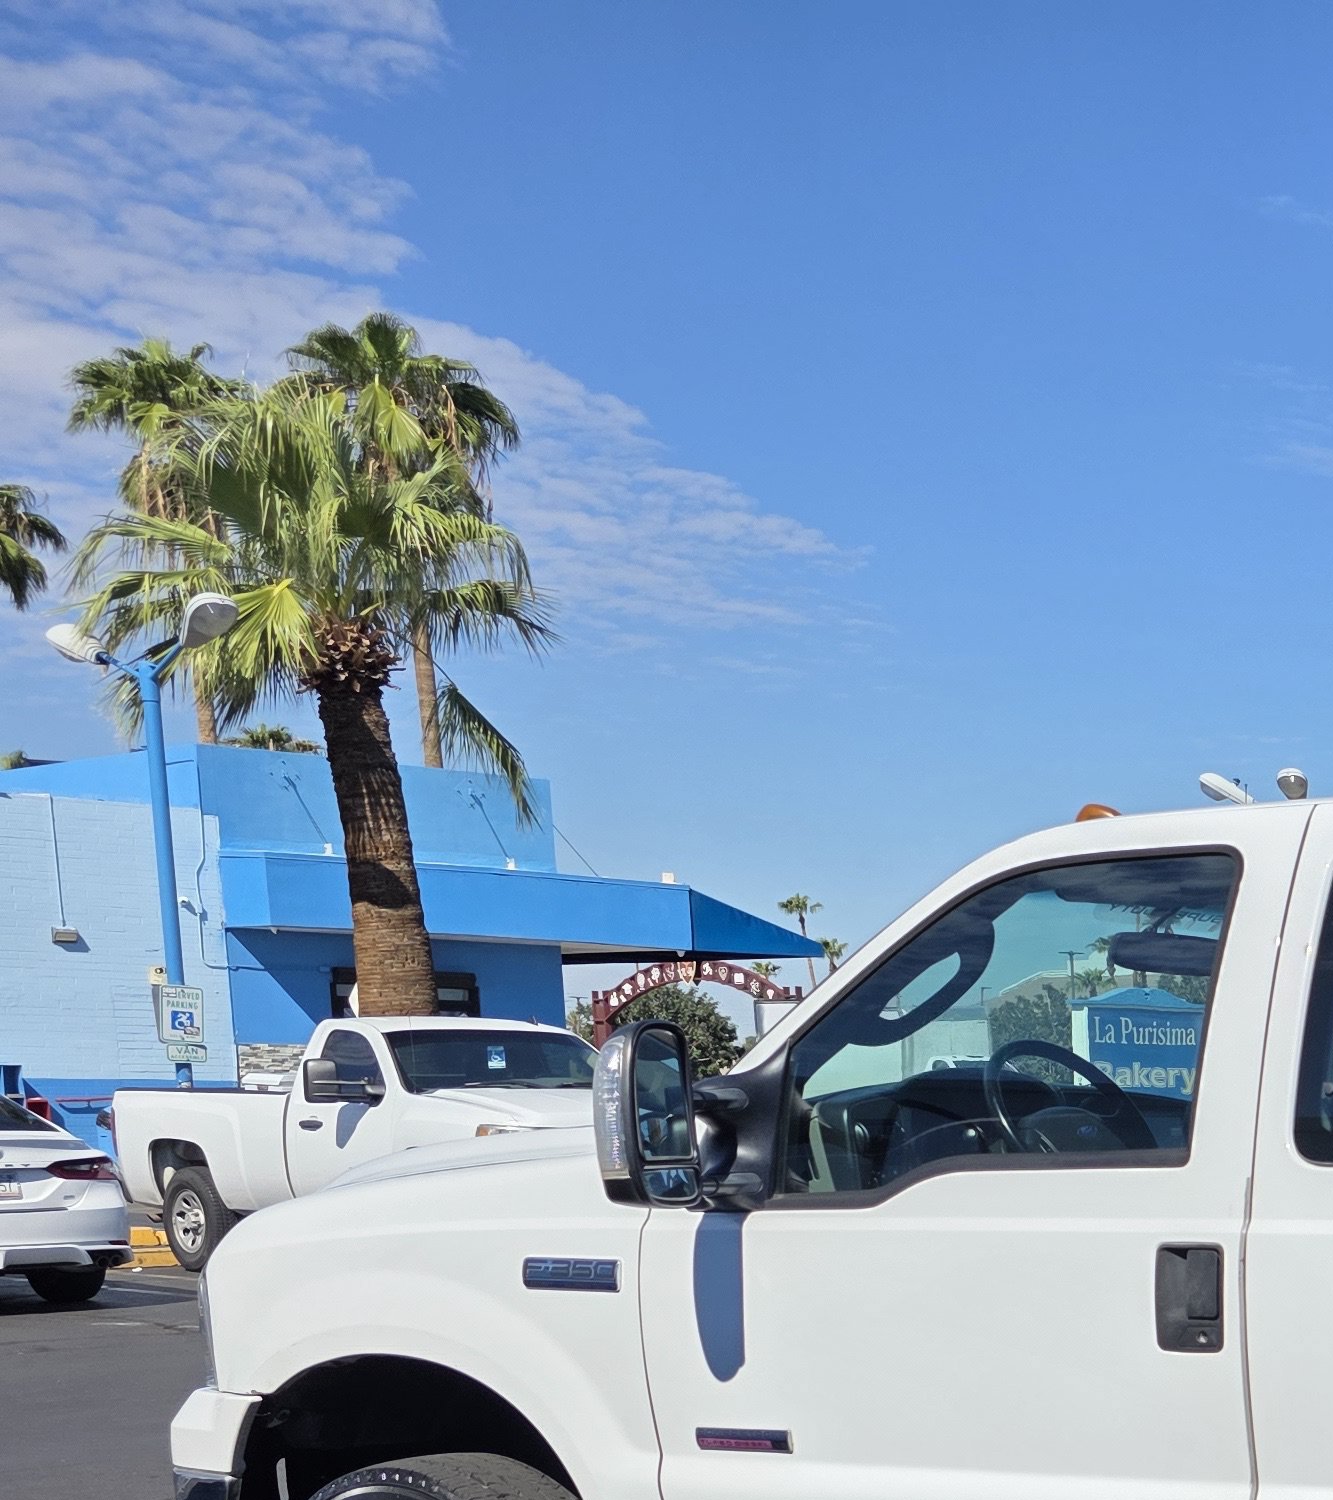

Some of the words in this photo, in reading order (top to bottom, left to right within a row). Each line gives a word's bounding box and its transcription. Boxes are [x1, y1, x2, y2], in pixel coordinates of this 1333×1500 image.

[166, 1000, 198, 1010] PARKING
[1094, 1016, 1116, 1044] La
[1120, 1016, 1196, 1046] Purisima
[176, 1047, 198, 1055] VAN
[1093, 1061, 1196, 1095] Bakery
